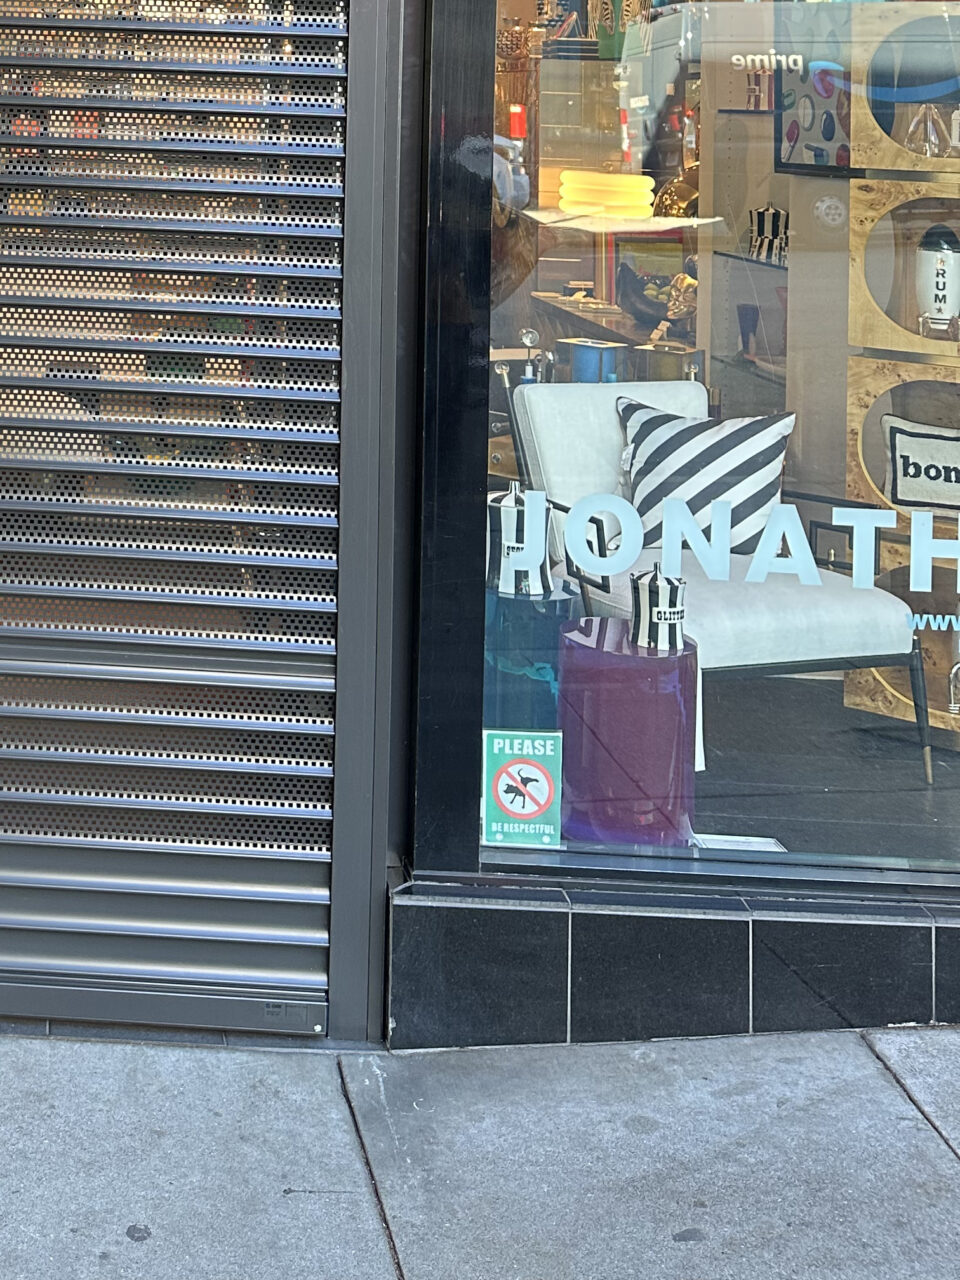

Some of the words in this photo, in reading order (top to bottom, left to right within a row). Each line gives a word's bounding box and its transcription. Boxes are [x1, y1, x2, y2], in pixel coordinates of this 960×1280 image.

[934, 268, 947, 304] RUM
[508, 489, 960, 594] JONATH
[493, 738, 555, 756] PLEASE
[491, 822, 503, 832] BE
[503, 823, 555, 835] RESPECTFUL
